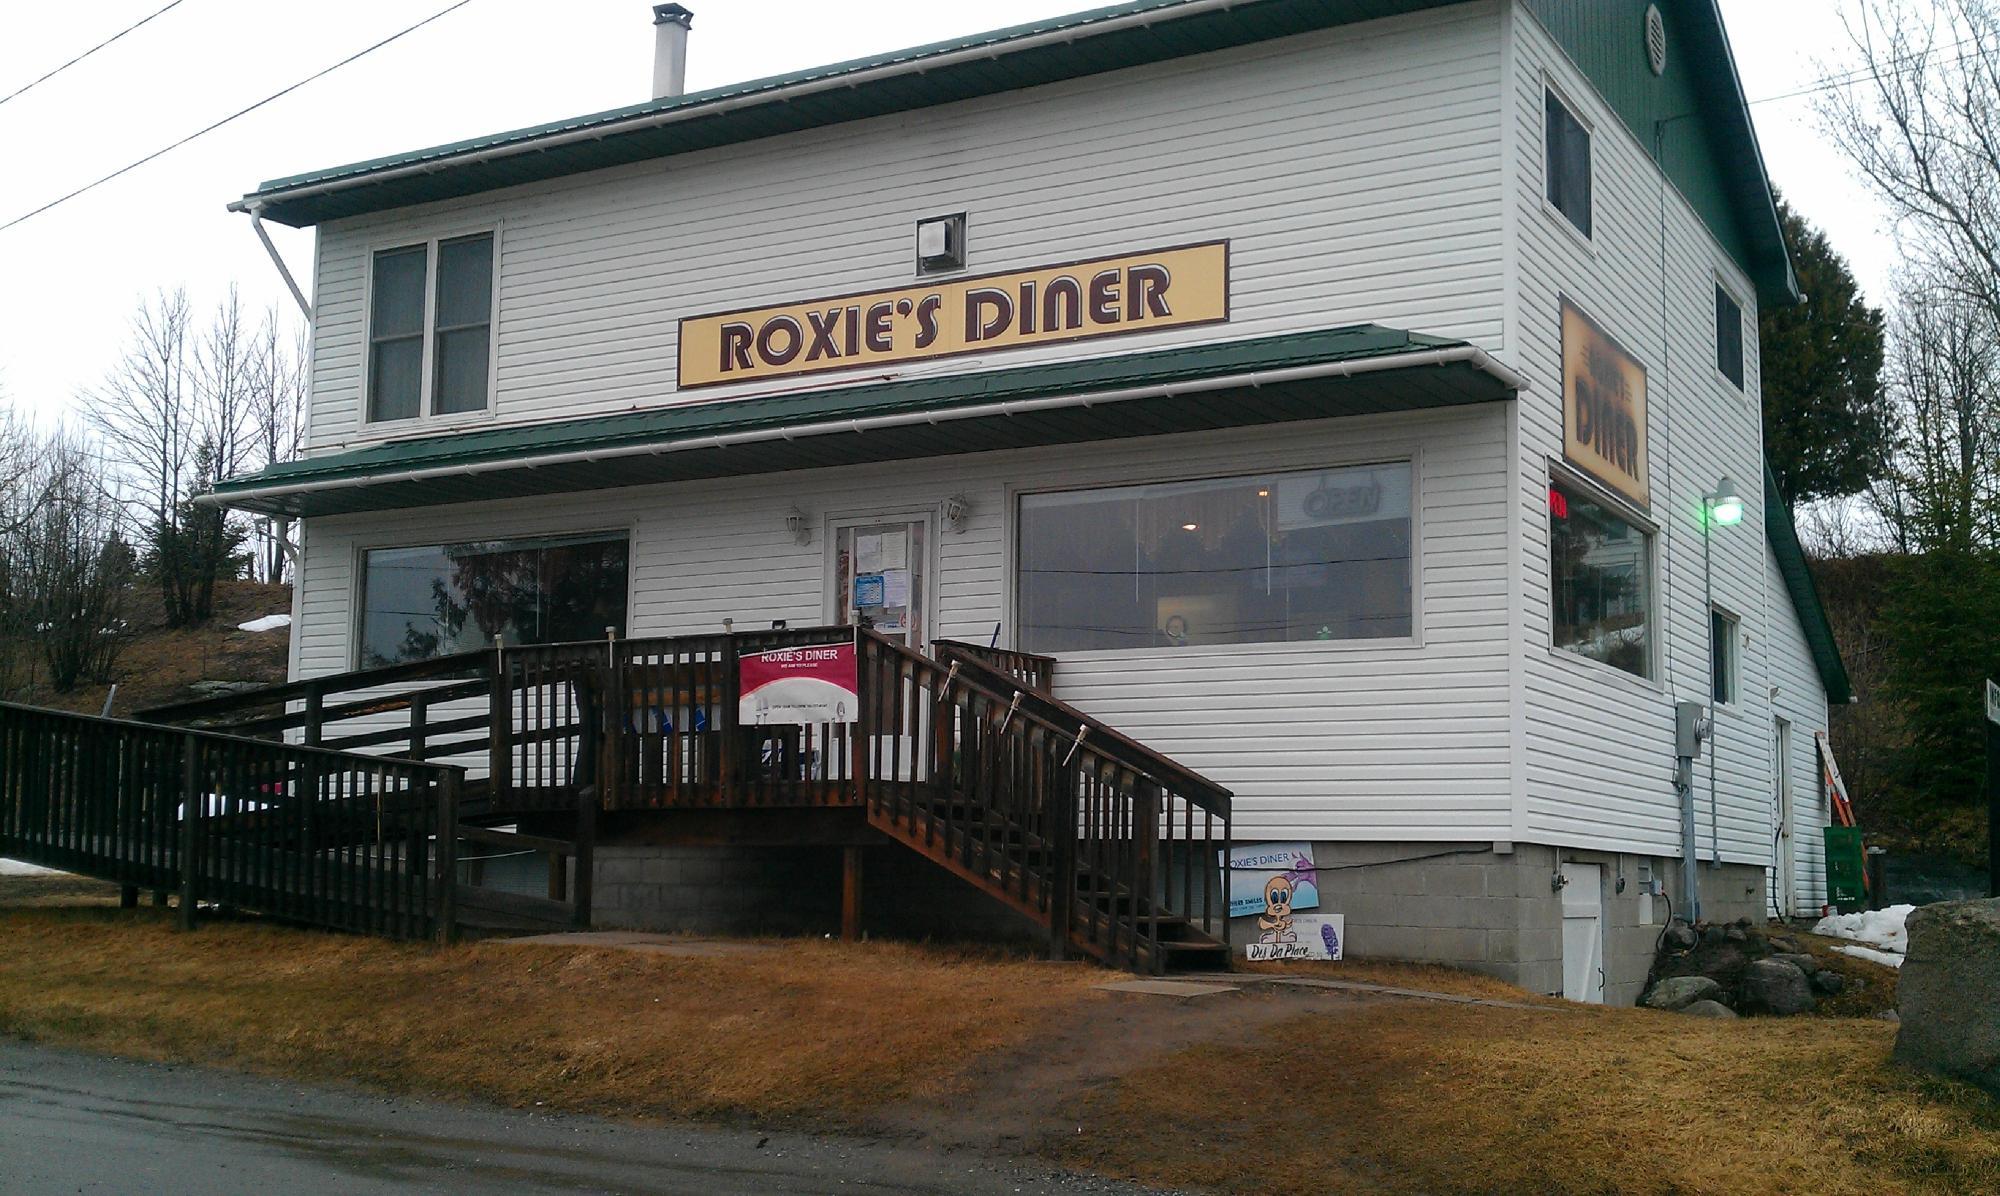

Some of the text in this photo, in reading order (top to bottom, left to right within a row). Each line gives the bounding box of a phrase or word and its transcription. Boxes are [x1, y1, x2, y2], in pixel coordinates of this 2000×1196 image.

[720, 263, 1172, 372] ROXIE'S DINER
[761, 649, 838, 663] ROXIE'S DINER
[1230, 852, 1290, 869] OXIE'S DINER
